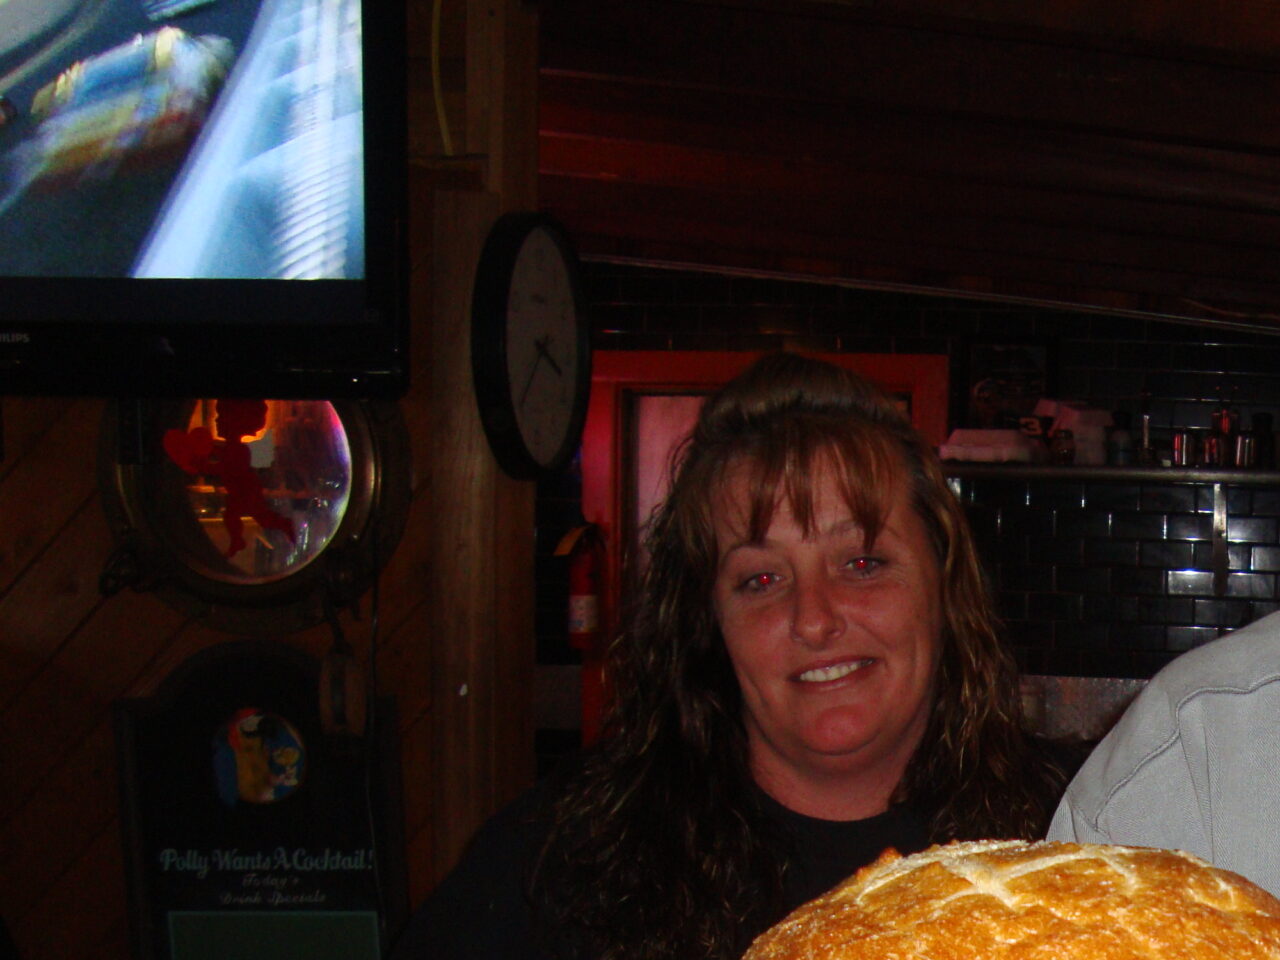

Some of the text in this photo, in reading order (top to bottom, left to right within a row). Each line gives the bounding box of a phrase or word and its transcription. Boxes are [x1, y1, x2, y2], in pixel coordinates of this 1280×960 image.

[160, 846, 374, 879] Polly Wants A Cocktail!
